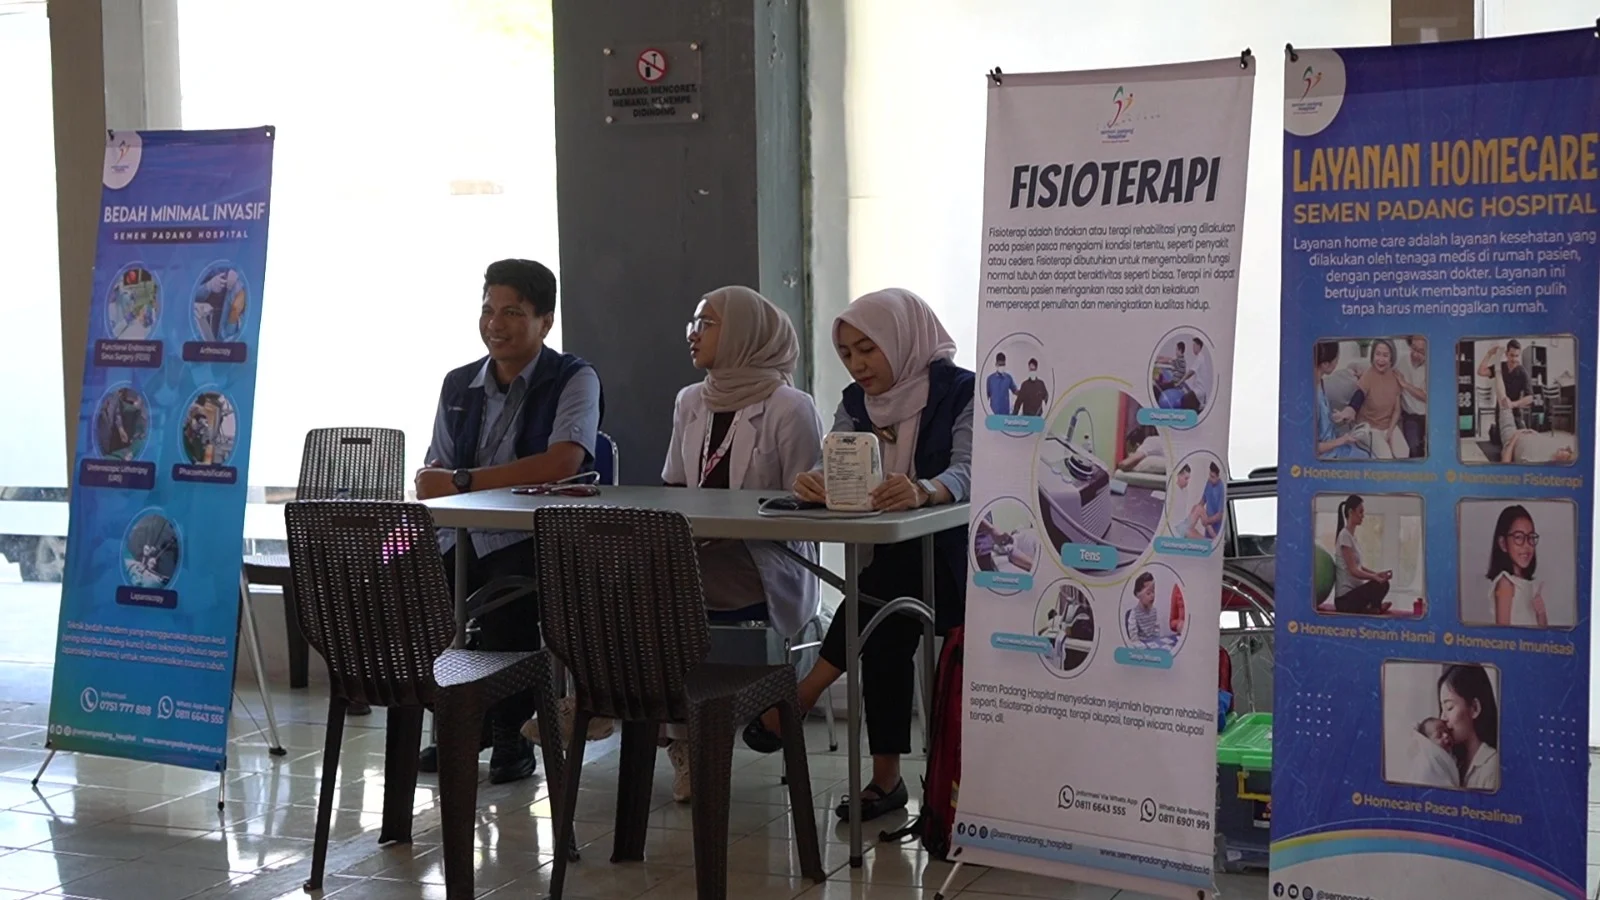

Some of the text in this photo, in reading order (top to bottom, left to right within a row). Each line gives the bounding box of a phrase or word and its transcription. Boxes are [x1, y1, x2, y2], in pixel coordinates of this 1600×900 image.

[609, 86, 649, 96] DILARANG
[633, 107, 675, 117] DIDINDING
[1293, 132, 1598, 192] LAYANAN HOMECARE
[1010, 156, 1220, 209] FISIOTERAPI
[104, 203, 266, 223] BEDAH MINIMAL INVASIF
[1294, 193, 1597, 224] SEMEN PADANG HOSPITAL
[114, 231, 248, 241] SEMEN PADANG HOSPITAL
[989, 223, 1235, 239] Fisioterapi adalah tindakan atau terapi rehabilitasi yang dilakukan
[989, 238, 1229, 253] pada pasien pasca mengalami kondisi tertentu, seperti penyakit
[1294, 231, 1596, 252] Layanan home care adalah layanan kesehatan yang
[988, 253, 1230, 267] atau cedera. Fisioterapi dibutuhkan untuk mengembalikan fungsi
[1309, 247, 1581, 266] dilakukan oleh tenaga medis di rumah pasien,
[988, 268, 1235, 281] normal tubuh dan dapat beraktivitas seperti biasa. Terapi ini dapat
[1326, 264, 1565, 284] dengan pengawasan dokter. Layanan ini
[987, 284, 1199, 297] membantu pasien meringankan rasa sakit dan kekakuan
[1325, 282, 1566, 300] bertujuan untuk membantu pasien pulih
[986, 300, 1040, 312] mempercepat
[1041, 299, 1079, 312] pemulihan
[1081, 300, 1095, 309] dan
[1155, 299, 1184, 310] kualitas
[1186, 299, 1210, 312] hidup.
[1342, 300, 1548, 316] tanpa harus meninggalkan rumah.
[1304, 467, 1359, 479] Homecare
[1523, 473, 1583, 489] Fisioterapi
[1080, 550, 1100, 562] Tens
[1300, 623, 1435, 643] Homecare Senam Hamil
[1456, 634, 1574, 655] Homecare Imunisasi
[970, 681, 997, 693] Semen
[999, 684, 1026, 700] Padang
[1028, 688, 1056, 700] Hospital
[1057, 692, 1106, 708] menyediakan
[1108, 698, 1141, 712] sejumlah
[1143, 702, 1174, 716] layanan
[119, 702, 134, 713] 777
[175, 709, 224, 724] 0811 6643 555
[999, 698, 1033, 714] fisioterapi
[1070, 708, 1090, 722] terapi
[1123, 715, 1145, 729] terapi
[1176, 723, 1204, 736] okupasi
[1075, 800, 1126, 816] 0811 6643 555
[1110, 795, 1126, 803] Whats
[1127, 798, 1138, 806] App
[1159, 803, 1209, 819] Whats App Booking
[1364, 794, 1522, 825] Homecare Pasca Persalinan
[1158, 814, 1210, 830] 0811 6901 999
[990, 828, 1073, 851] @semenpadang_hospital
